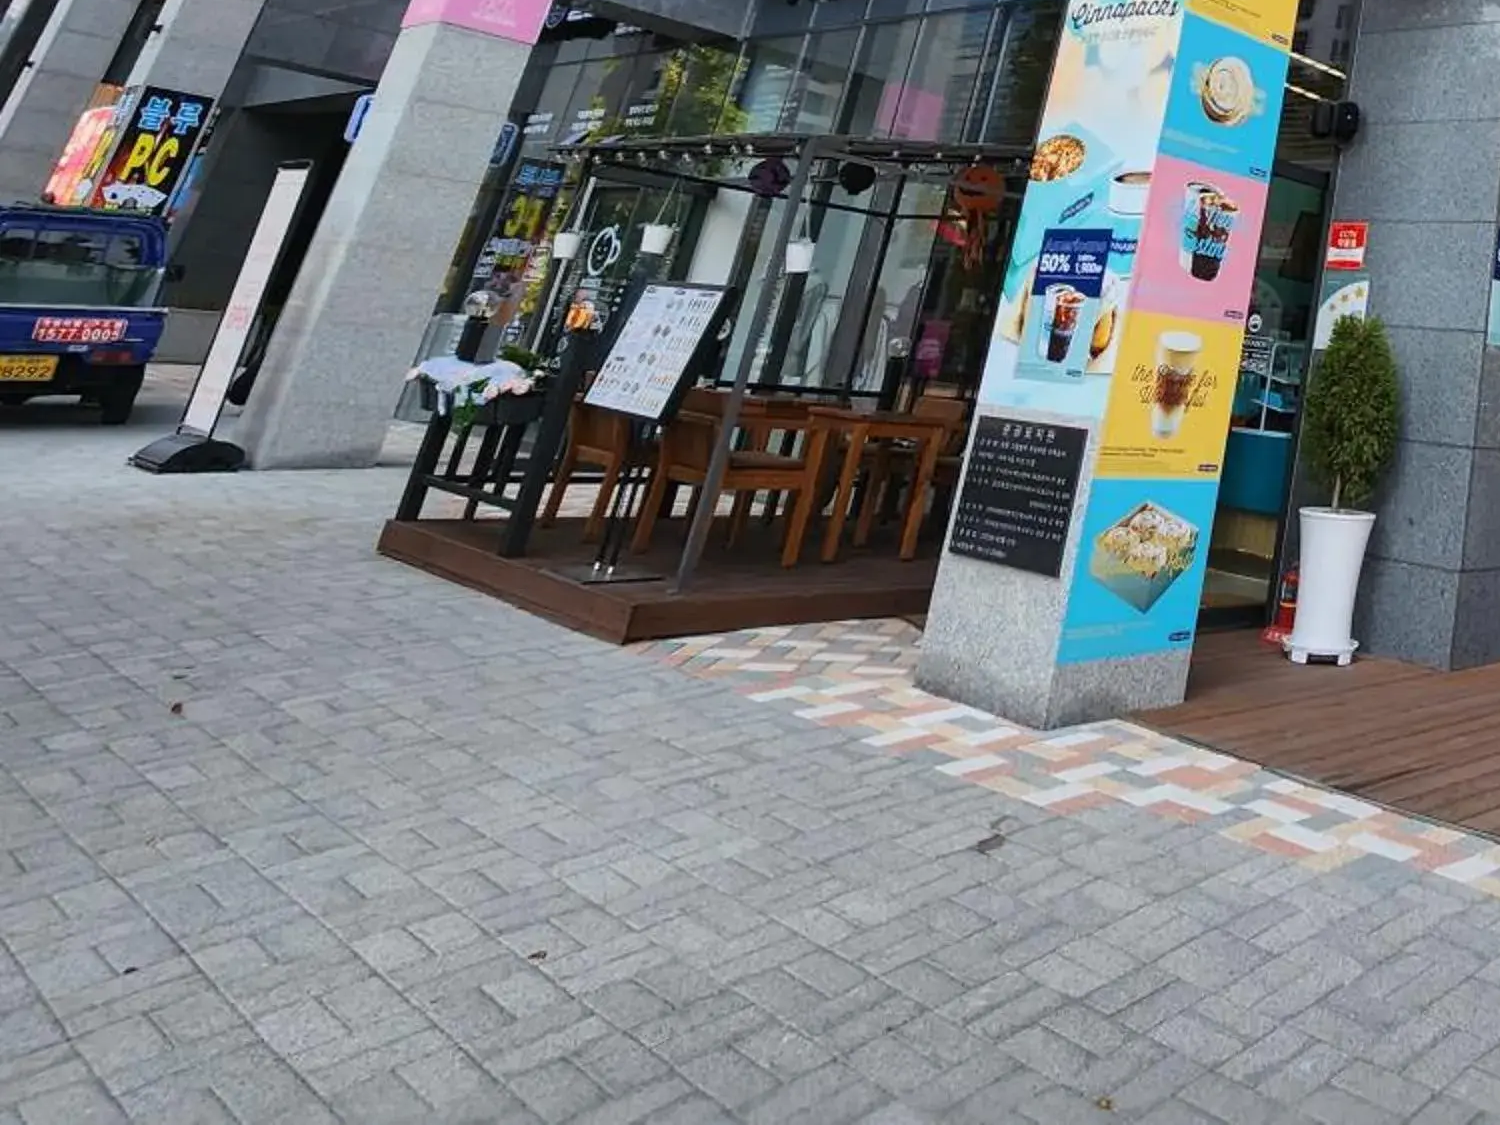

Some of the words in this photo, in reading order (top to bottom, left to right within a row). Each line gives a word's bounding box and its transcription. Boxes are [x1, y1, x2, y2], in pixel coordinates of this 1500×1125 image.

[138, 96, 203, 135] 블루
[119, 133, 180, 186] PC
[1039, 253, 1071, 273] 50%
